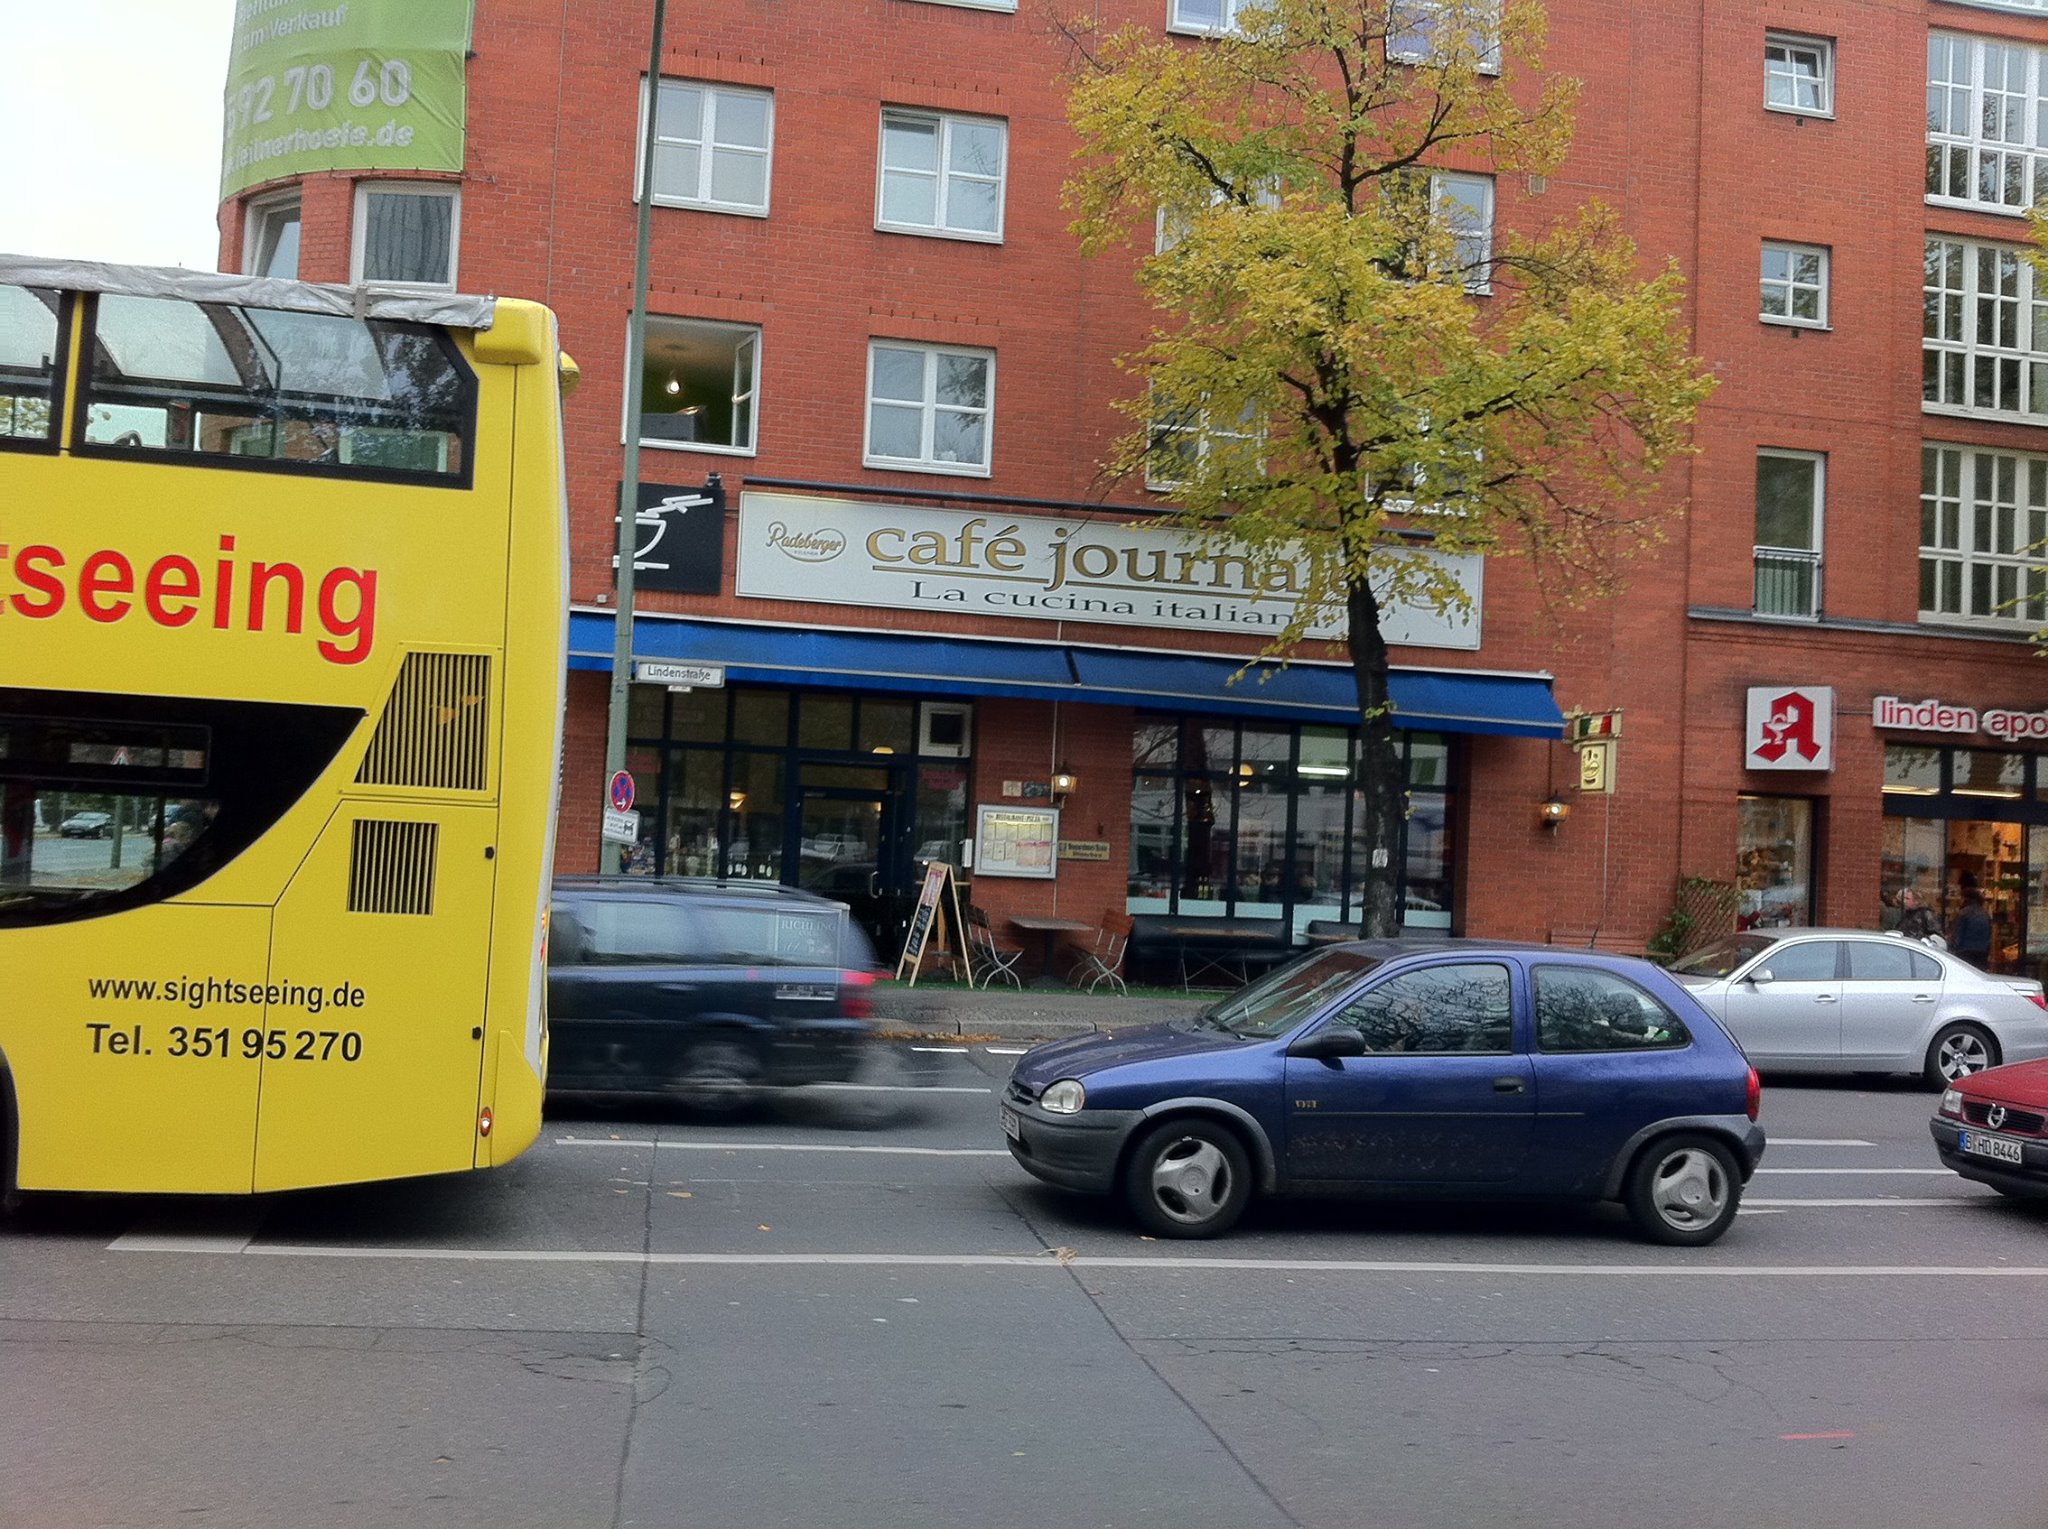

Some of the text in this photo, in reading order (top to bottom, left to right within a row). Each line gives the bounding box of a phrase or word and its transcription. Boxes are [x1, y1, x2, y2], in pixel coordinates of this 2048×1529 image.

[269, 4, 349, 41] Verkauf
[283, 64, 335, 114] 70
[349, 60, 413, 108] 60
[765, 520, 845, 560] Radeberger
[866, 517, 1027, 573] café
[910, 580, 969, 603] La
[983, 592, 1135, 617] cucina
[647, 665, 711, 682] Lindenstraße
[1881, 700, 1974, 729] linden
[88, 976, 366, 1013] www.sightseeing.de
[86, 1023, 152, 1056] Tel.
